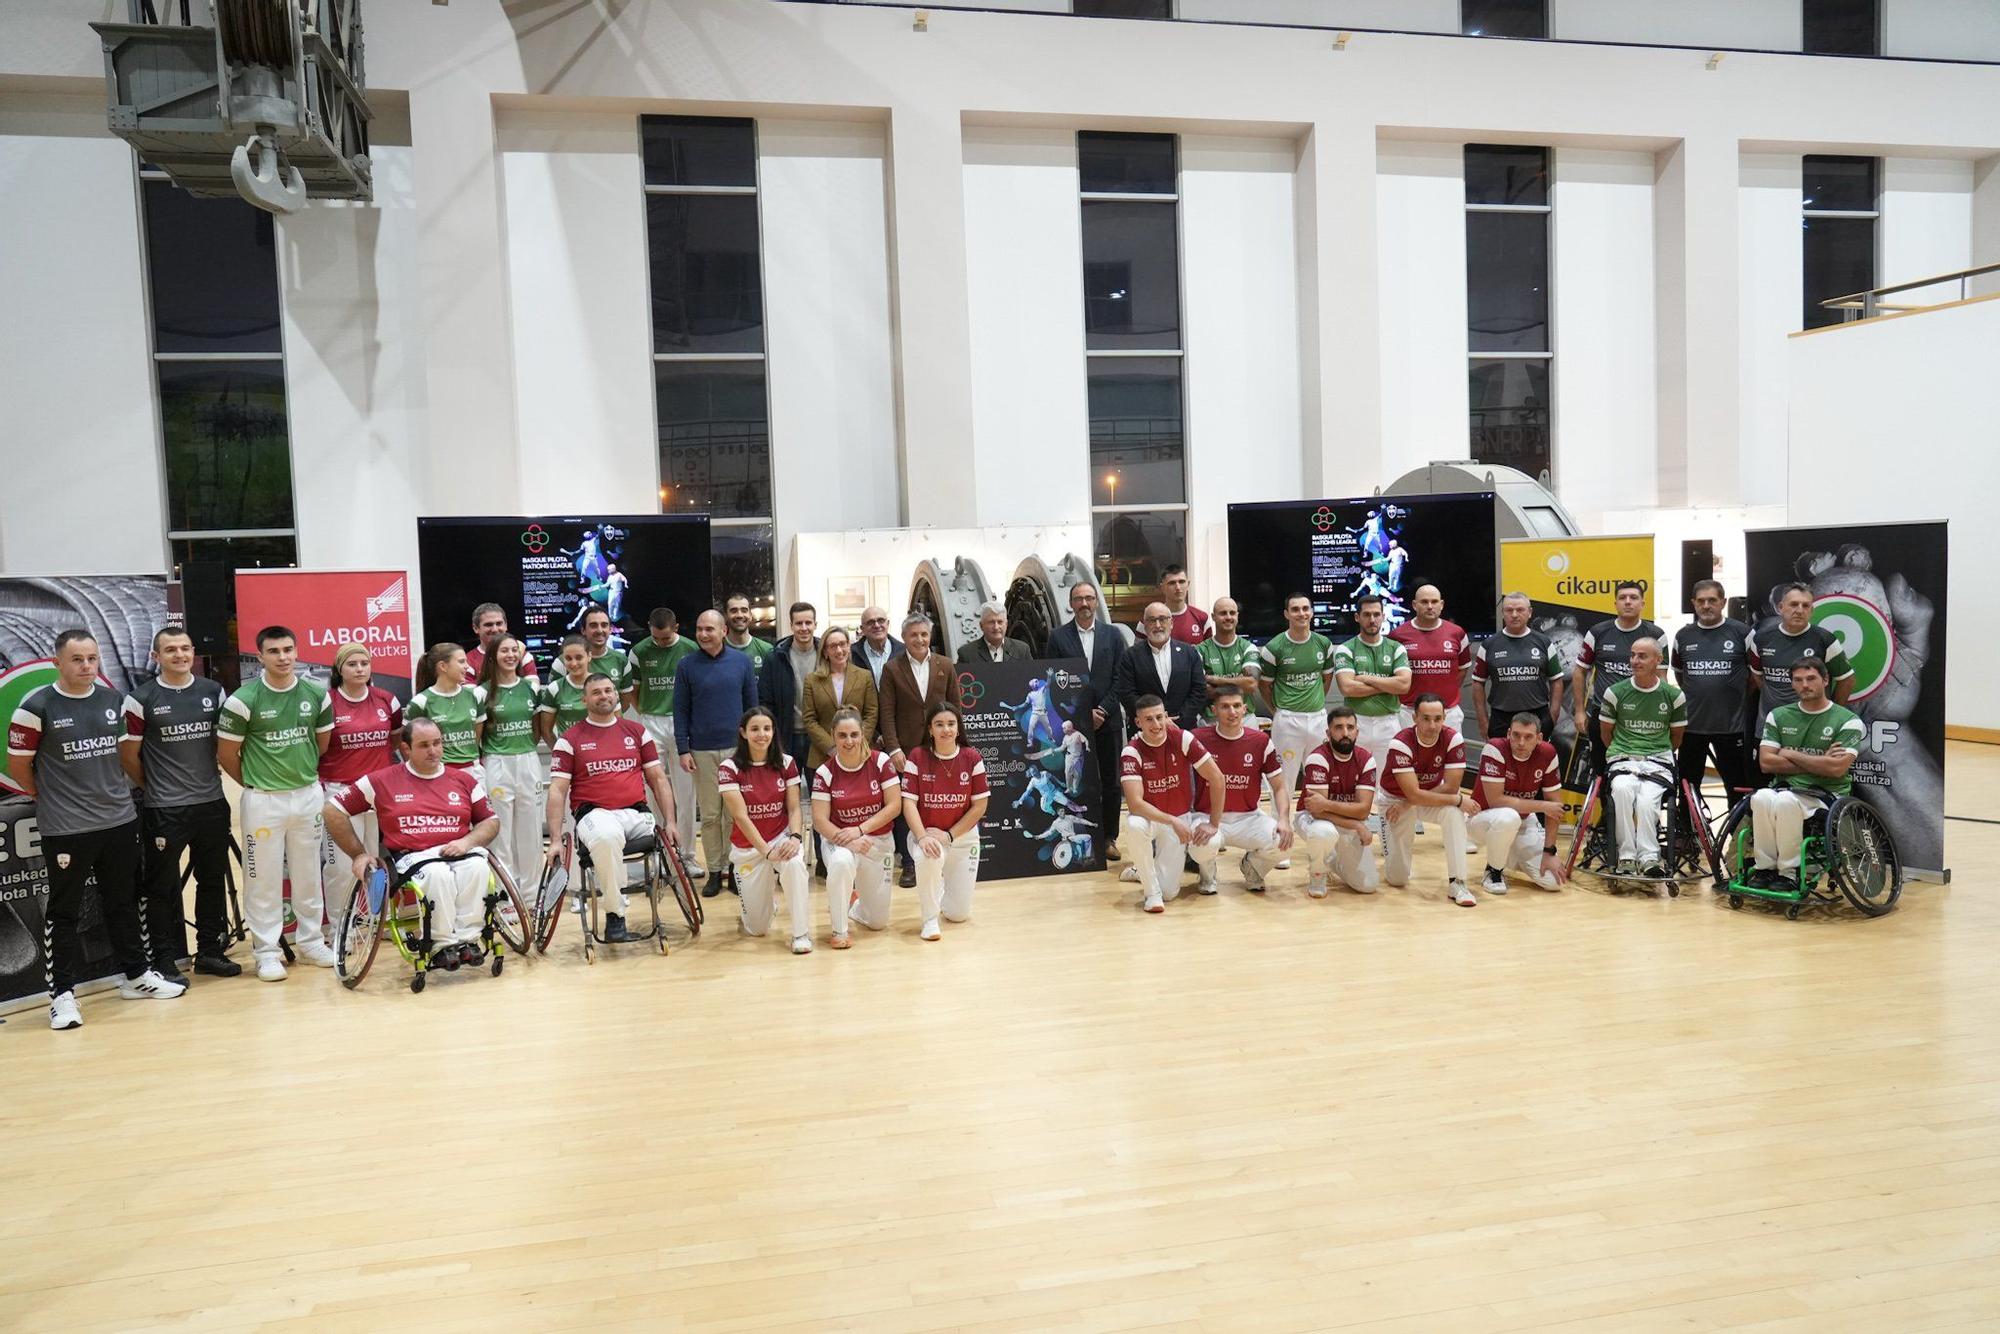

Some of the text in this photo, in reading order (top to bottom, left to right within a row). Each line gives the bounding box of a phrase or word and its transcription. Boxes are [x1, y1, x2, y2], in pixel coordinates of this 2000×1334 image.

[309, 625, 407, 646] LABORAL
[370, 645, 408, 658] kutxa
[1687, 661, 1732, 670] EUSKADI
[1497, 667, 1540, 676] EUSKADI
[962, 713, 1010, 723] SQUE PILOTA
[963, 720, 1017, 731] TIONS LEAGUE
[1625, 719, 1664, 729] EUSKADI
[340, 730, 390, 744] EUSKADI
[62, 735, 118, 754] EUSKADI
[586, 758, 637, 772] EUSKADI
[1224, 775, 1250, 784] KADI
[924, 793, 967, 803] EUSKADI
[397, 815, 461, 828] EUSKADI
[428, 826, 461, 834] COUNTRY
[246, 834, 257, 878] cikautxo
